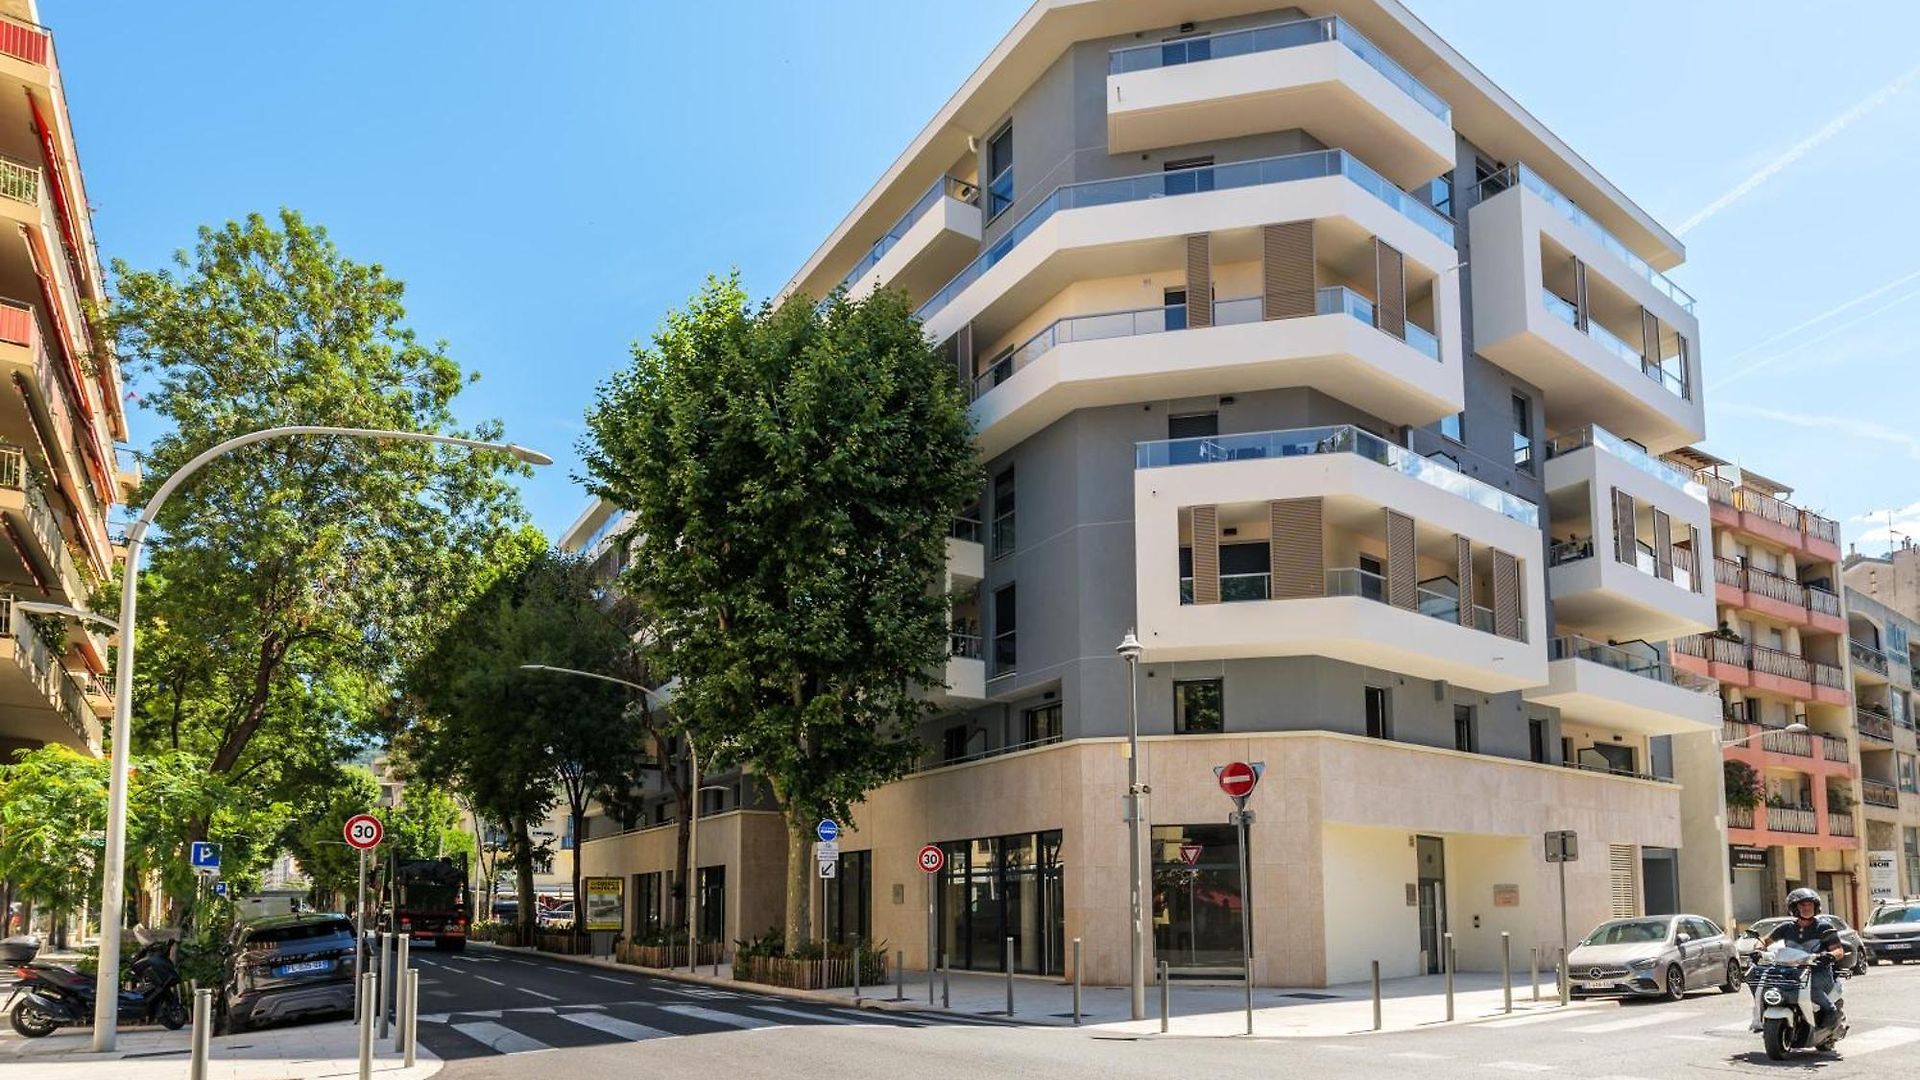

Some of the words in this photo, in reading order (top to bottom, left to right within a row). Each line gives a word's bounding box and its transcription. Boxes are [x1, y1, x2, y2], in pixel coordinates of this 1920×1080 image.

[353, 825, 374, 838] 30
[200, 847, 213, 862] P
[924, 854, 938, 865] 30
